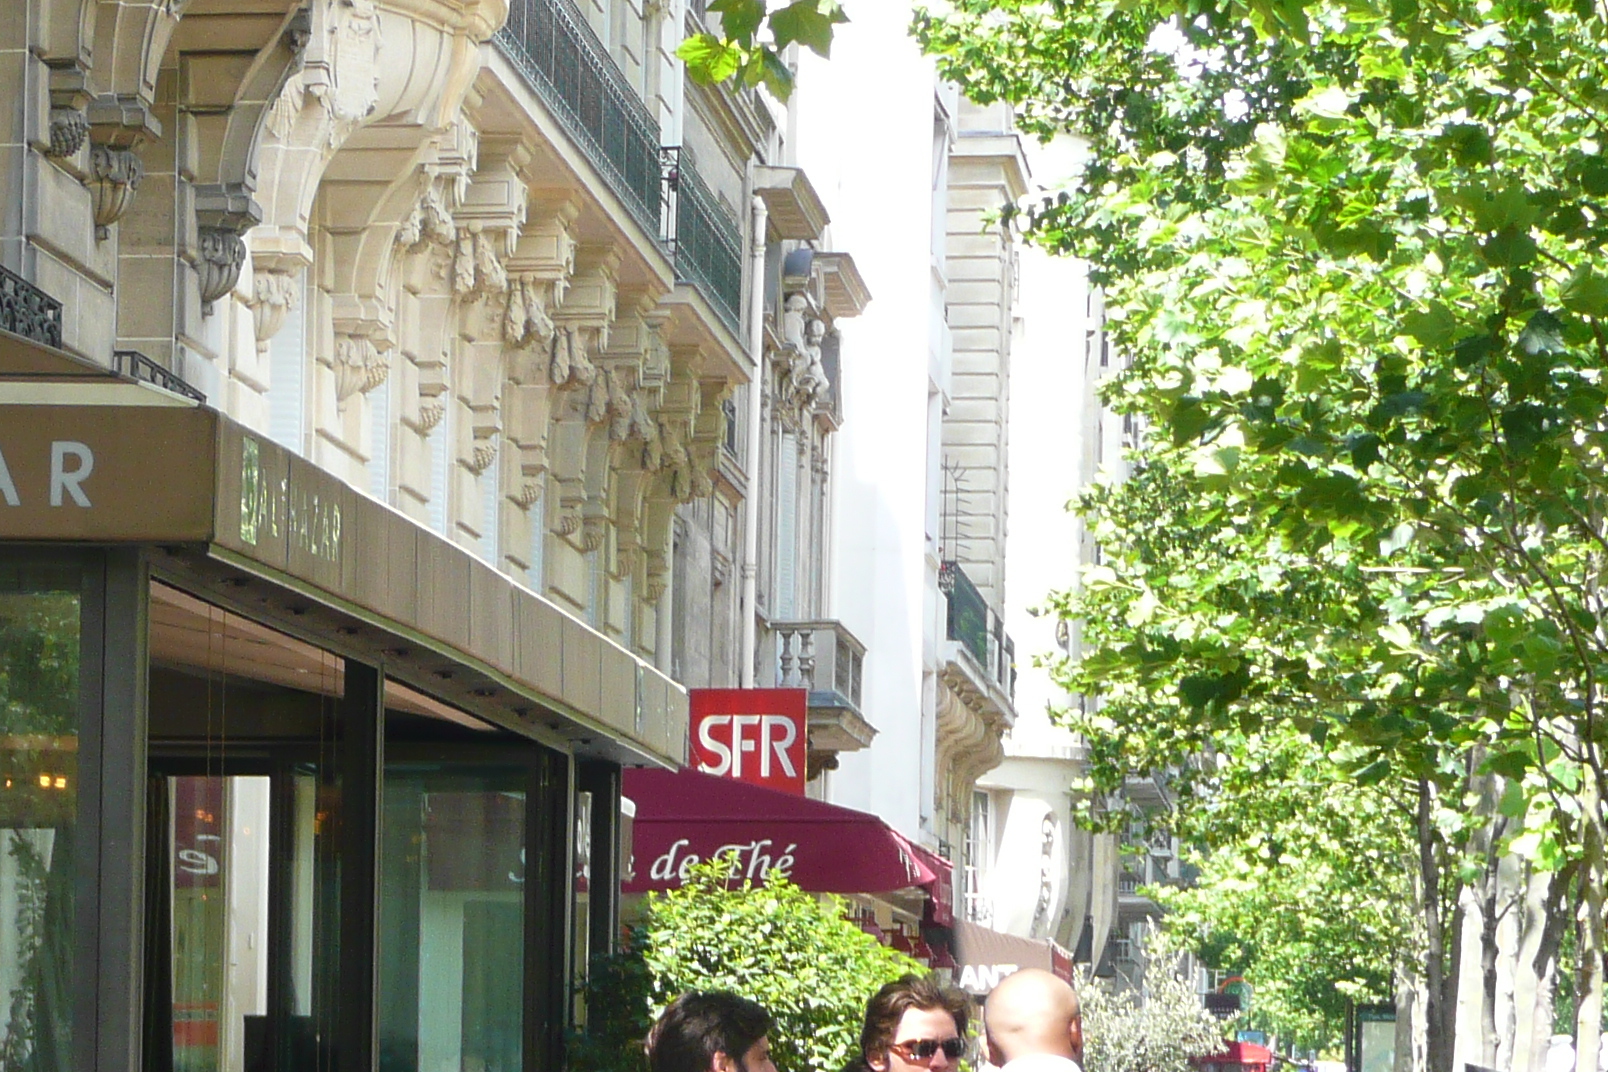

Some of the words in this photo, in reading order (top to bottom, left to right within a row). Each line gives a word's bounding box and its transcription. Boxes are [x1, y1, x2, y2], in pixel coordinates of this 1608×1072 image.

[698, 714, 798, 778] SFR
[650, 838, 699, 881] de
[714, 839, 797, 881] Thé
